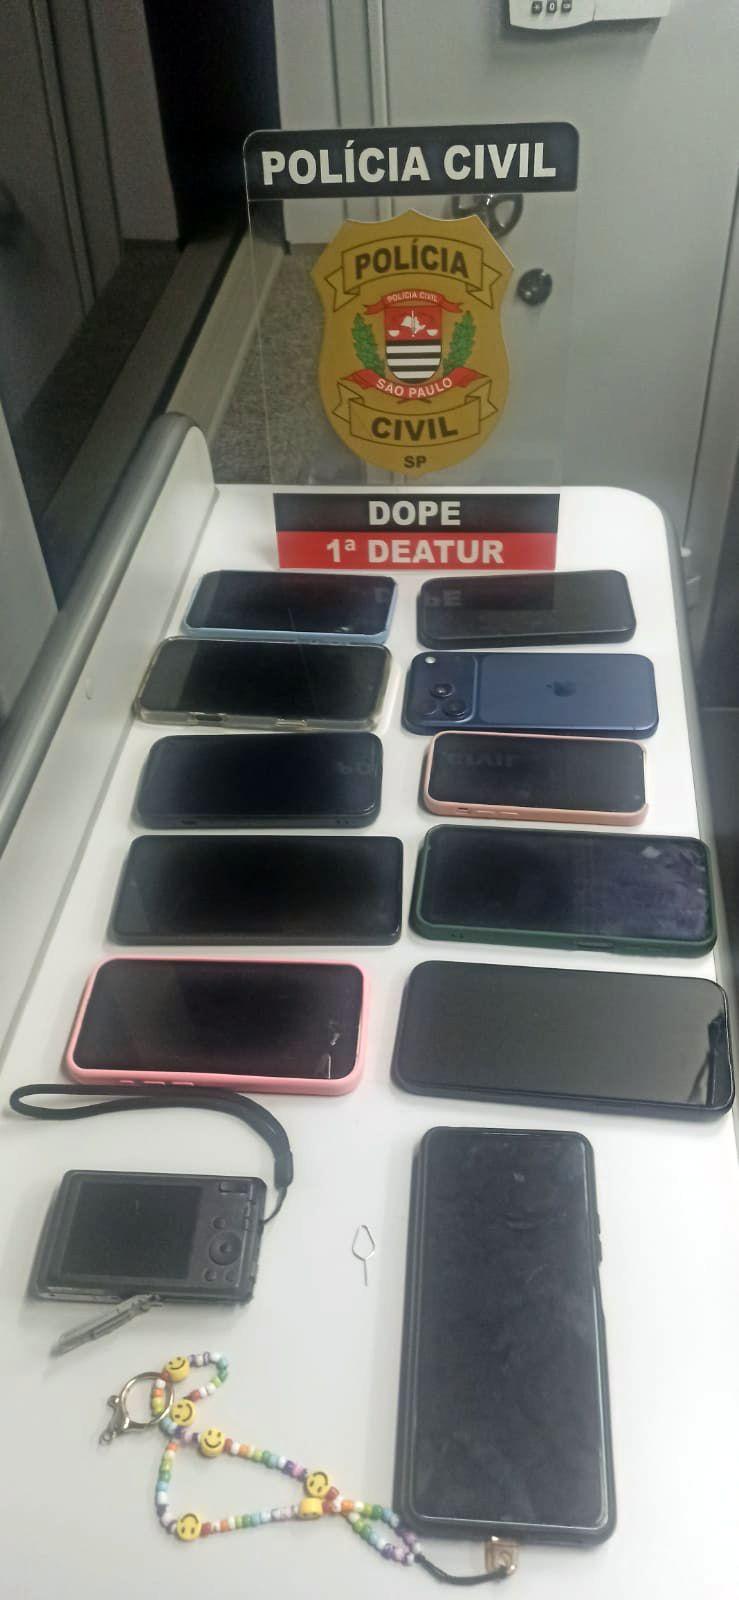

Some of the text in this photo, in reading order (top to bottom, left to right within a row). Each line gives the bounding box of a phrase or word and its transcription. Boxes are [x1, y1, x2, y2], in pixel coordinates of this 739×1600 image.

[262, 140, 556, 185] POLÍCIA CIVIL
[355, 239, 470, 280] POLÍCIA
[419, 291, 438, 304] CIVIL
[408, 377, 452, 398] PAULO
[371, 417, 459, 441] CIVIL
[403, 455, 427, 469] SP
[368, 500, 462, 527] DOPE
[326, 538, 504, 564] 1ª DEATUR
